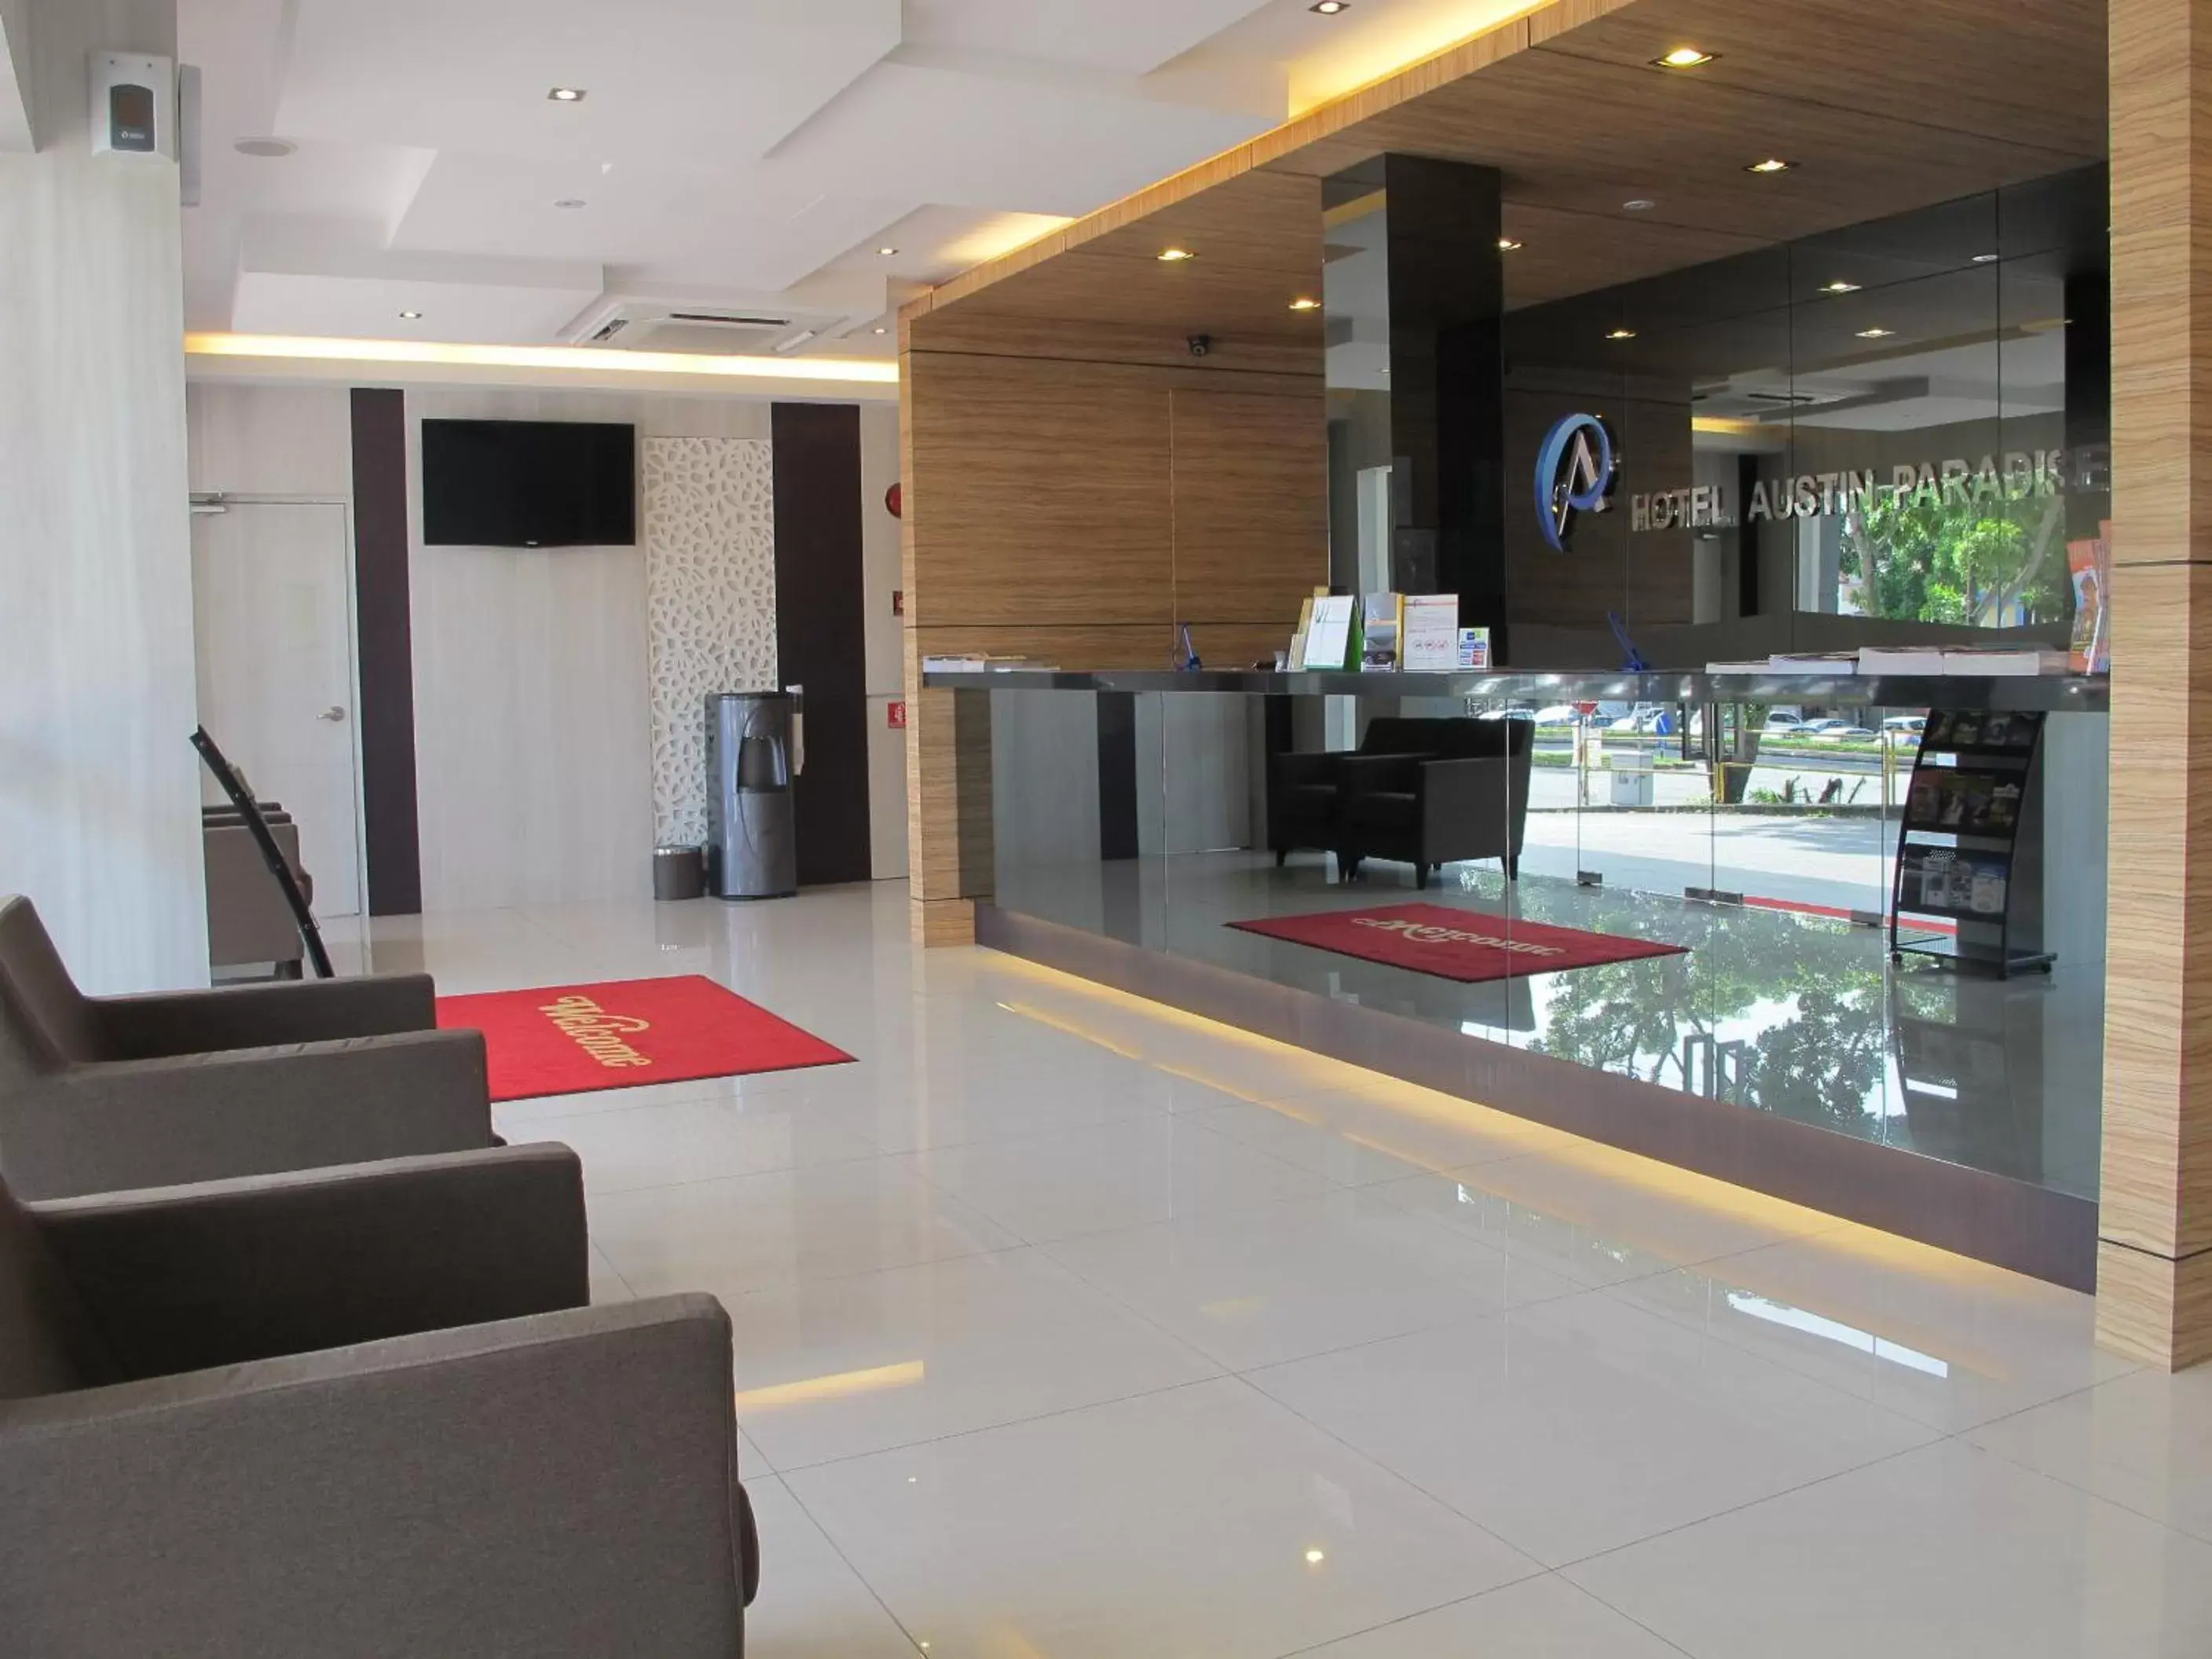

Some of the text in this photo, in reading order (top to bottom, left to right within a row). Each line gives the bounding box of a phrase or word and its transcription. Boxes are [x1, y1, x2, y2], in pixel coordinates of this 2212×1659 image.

[1632, 485, 1728, 532] HOTEL
[1747, 468, 1876, 522] AUSTIN
[538, 996, 652, 1067] Welcome
